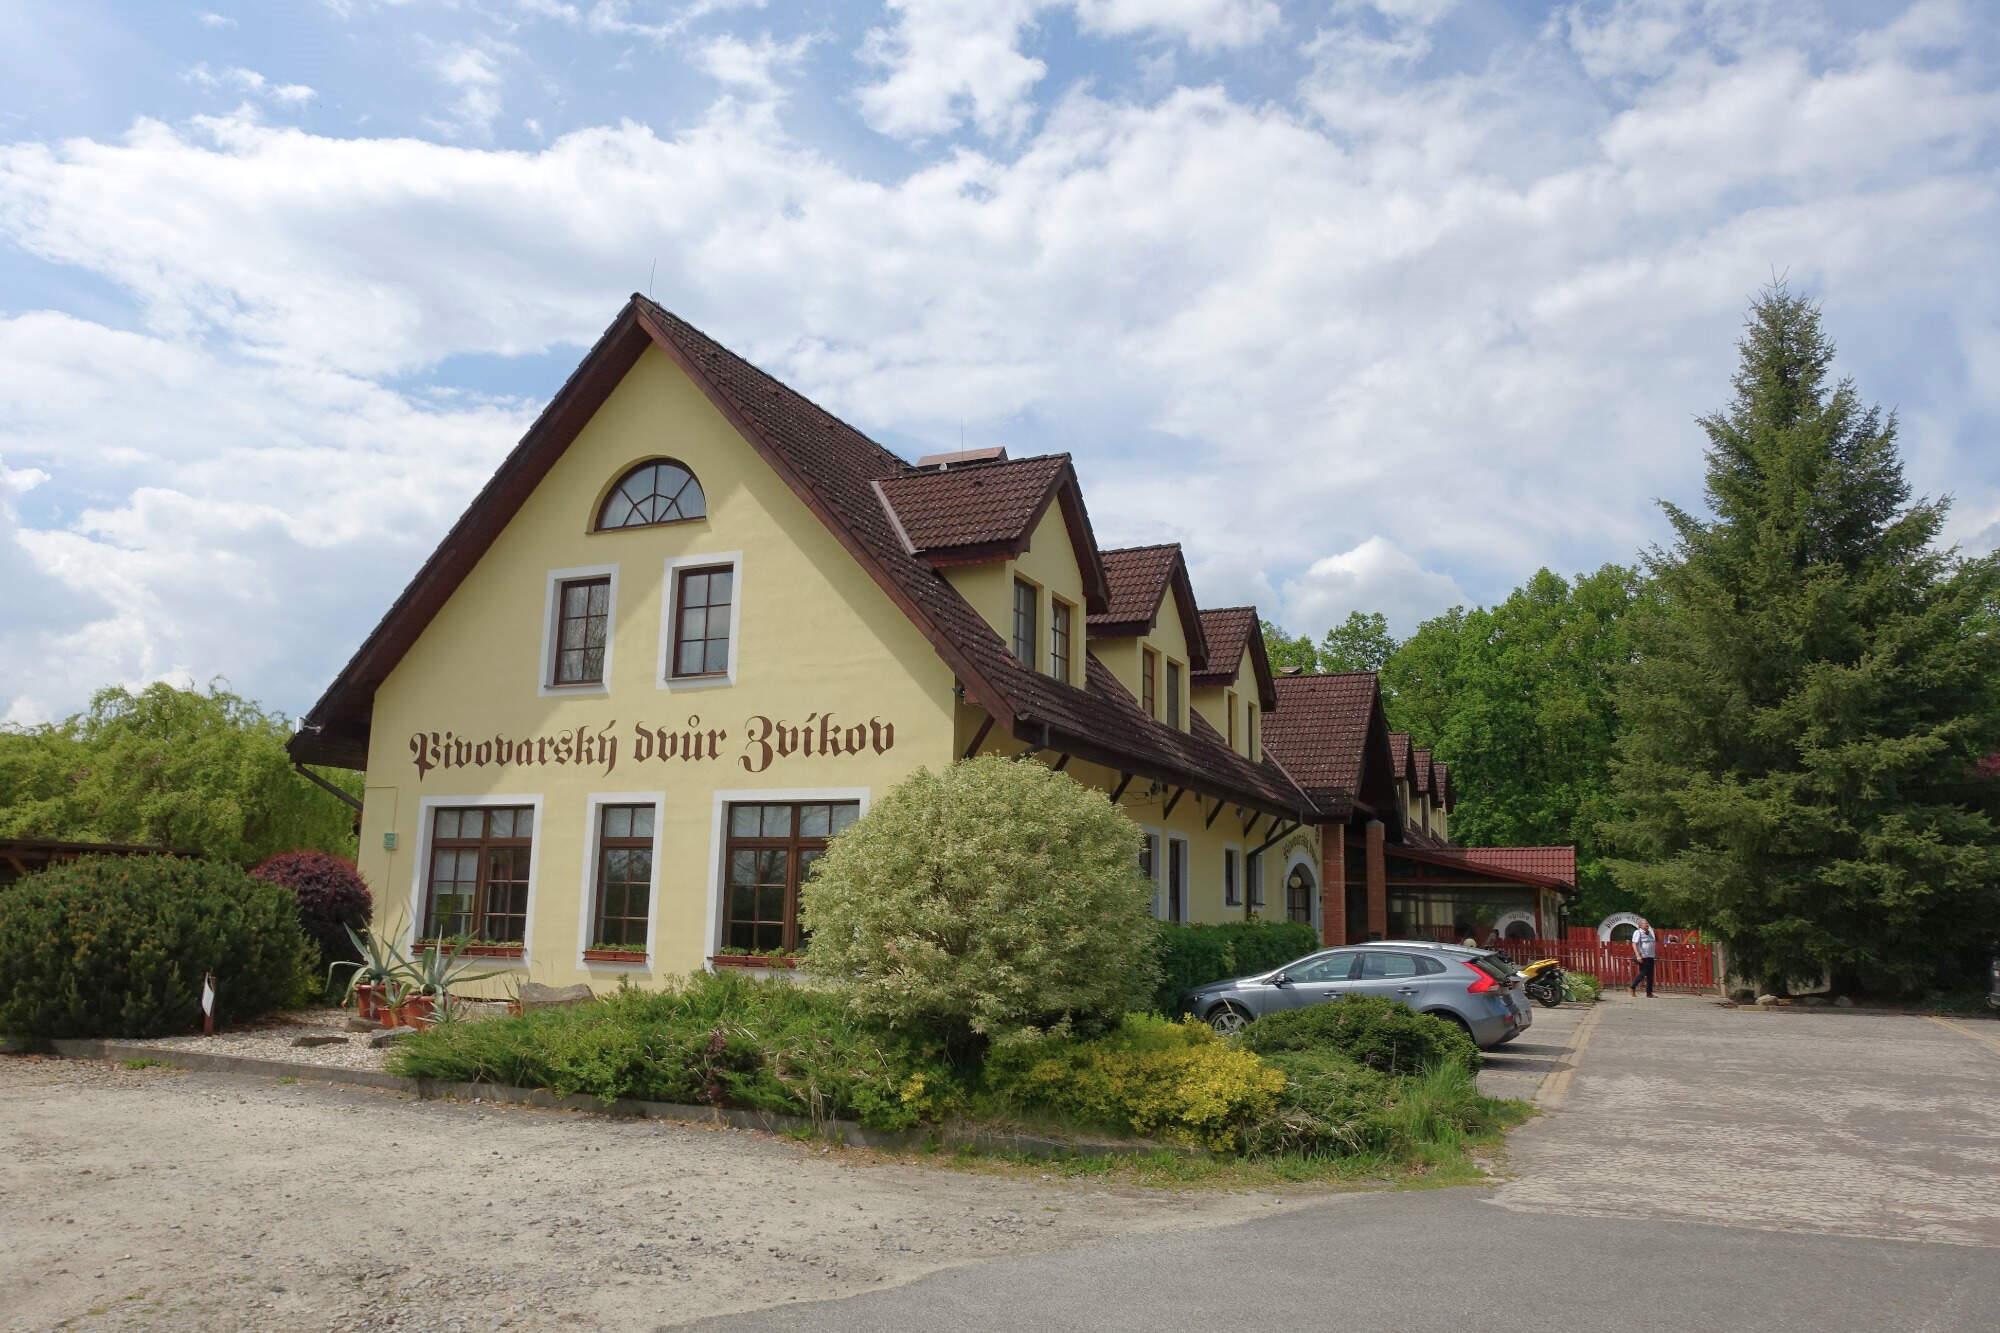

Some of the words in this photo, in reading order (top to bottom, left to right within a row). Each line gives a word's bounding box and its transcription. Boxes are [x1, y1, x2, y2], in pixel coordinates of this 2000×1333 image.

[409, 719, 617, 782] Pivovarský
[633, 714, 727, 763] dvůr
[737, 712, 895, 773] Zvíkov
